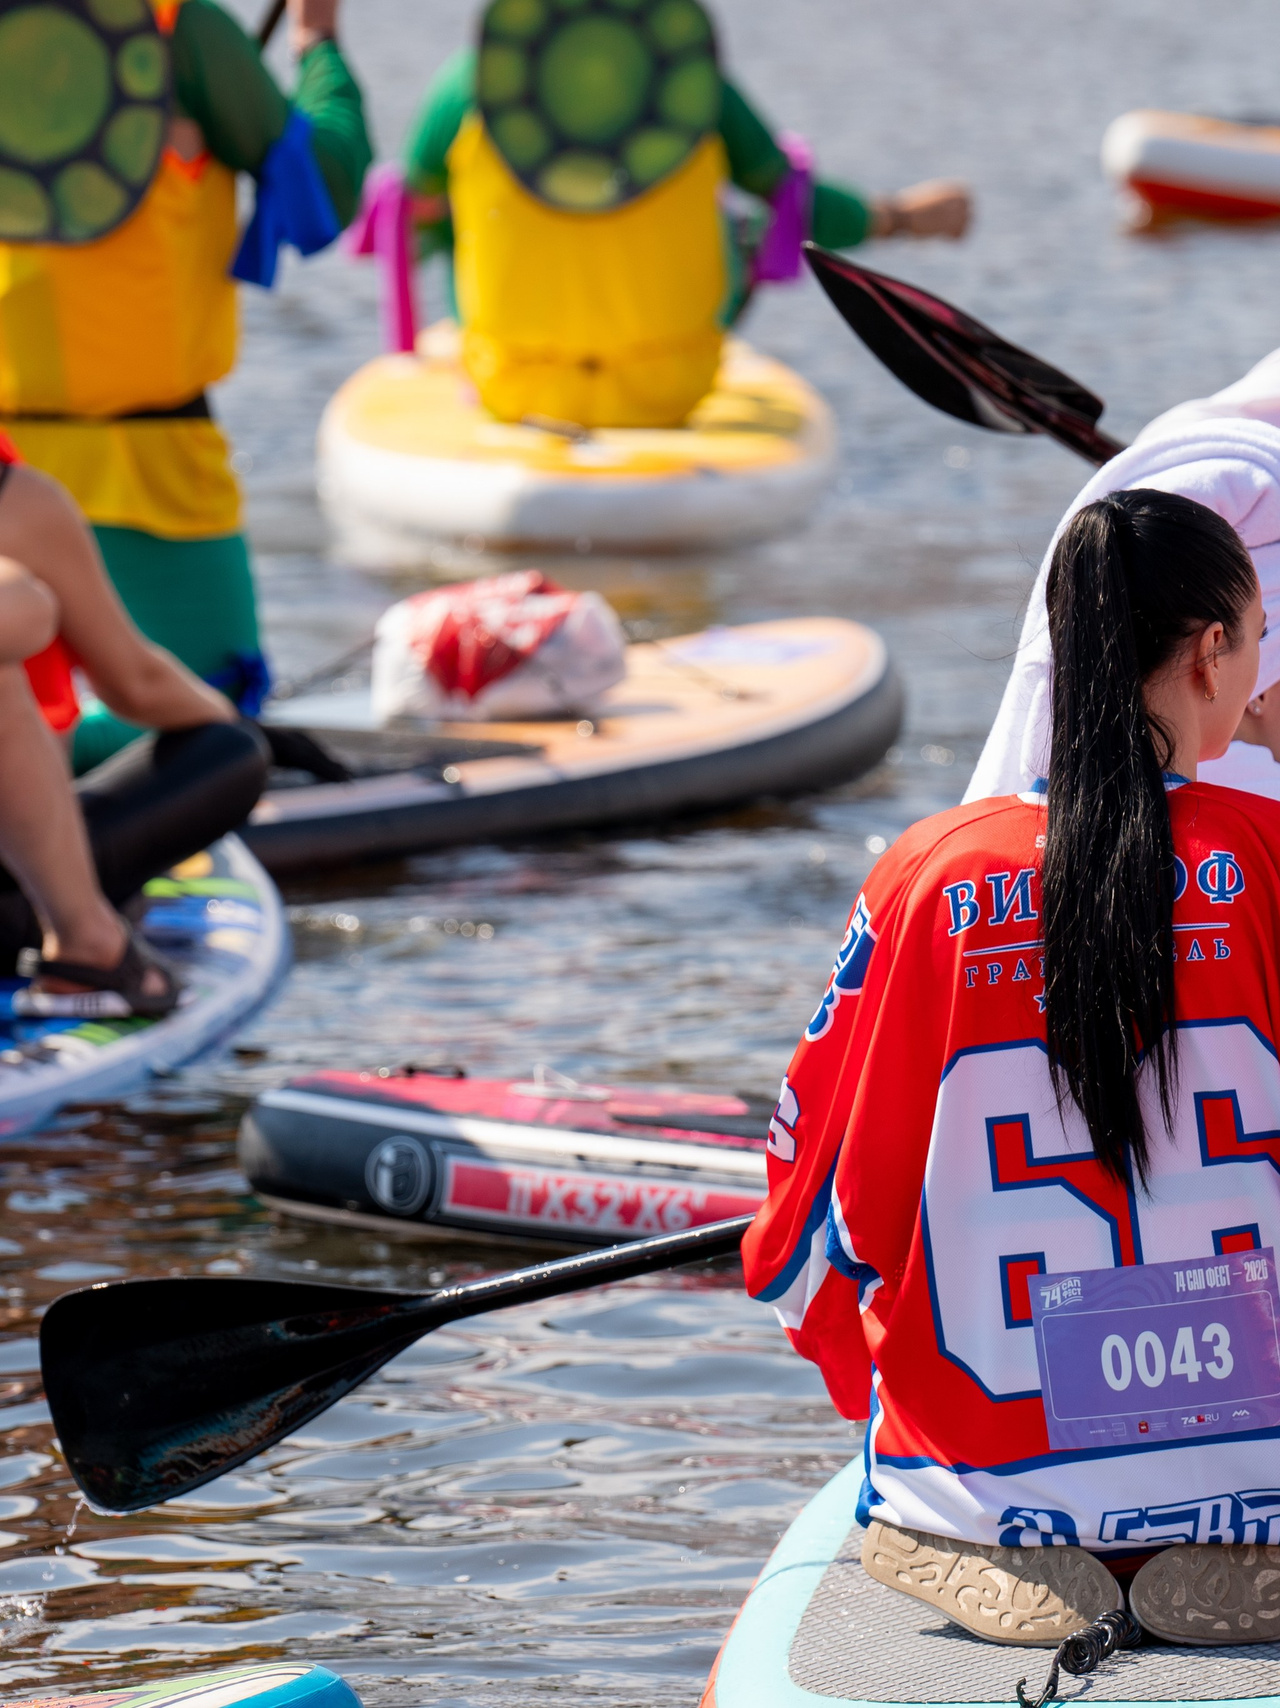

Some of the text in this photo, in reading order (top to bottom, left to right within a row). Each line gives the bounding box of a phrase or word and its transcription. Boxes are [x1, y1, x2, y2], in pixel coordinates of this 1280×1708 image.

[1061, 1279, 1081, 1290] САП
[1174, 1271, 1186, 1293] 74
[1186, 1267, 1206, 1291] САП
[1206, 1264, 1231, 1288] ФЕСТ
[1243, 1258, 1269, 1283] 2026
[1040, 1285, 1062, 1308] 74
[1101, 1322, 1234, 1392] 0043
